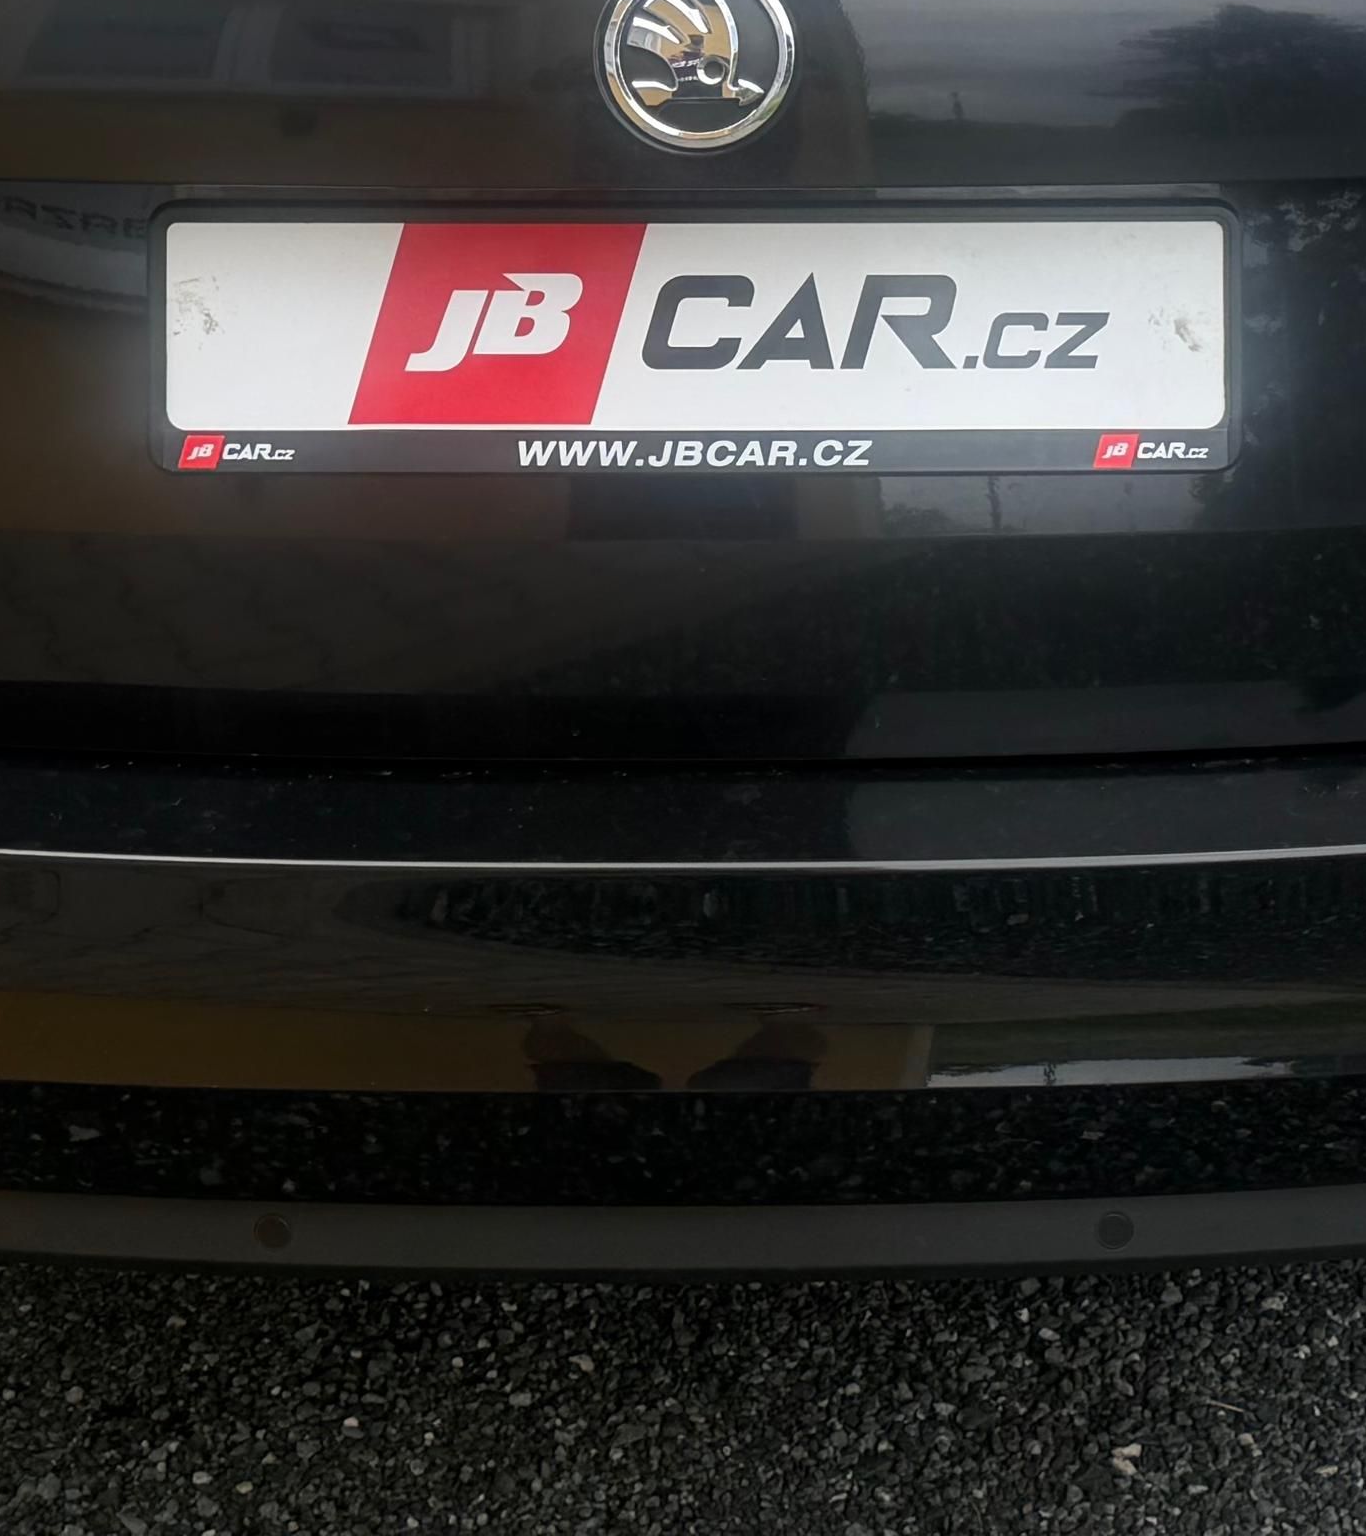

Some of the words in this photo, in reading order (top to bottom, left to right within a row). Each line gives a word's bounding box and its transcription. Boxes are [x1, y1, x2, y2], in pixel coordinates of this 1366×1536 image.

[404, 272, 584, 372] JB
[187, 443, 214, 460] JB
[518, 440, 873, 466] WWW.JBCAR.CZ
[1102, 442, 1129, 459] JB
